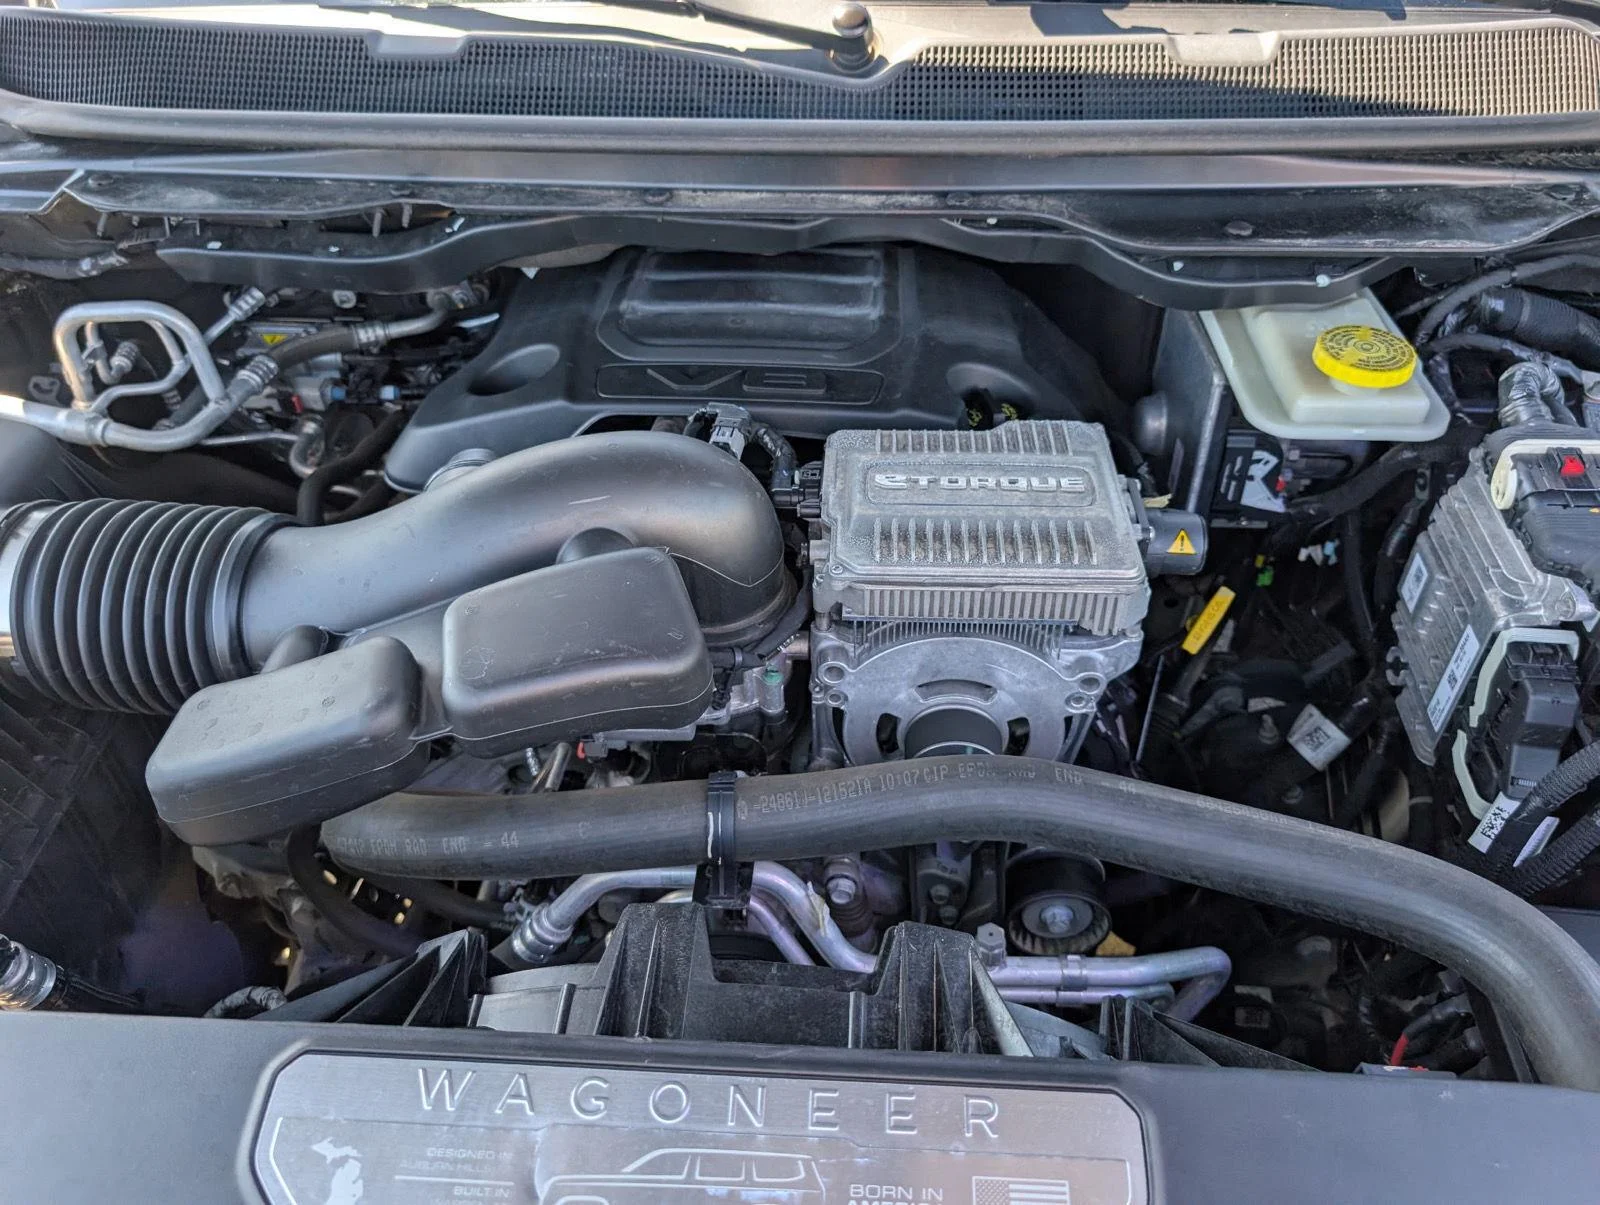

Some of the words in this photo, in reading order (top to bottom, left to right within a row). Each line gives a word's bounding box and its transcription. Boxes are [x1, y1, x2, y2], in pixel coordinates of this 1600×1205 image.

[501, 831, 520, 849] 44
[417, 1067, 1000, 1138] WAGONEER
[453, 1185, 491, 1197] BUILT
[850, 1183, 913, 1200] BORN
[922, 1187, 943, 1201] IN
